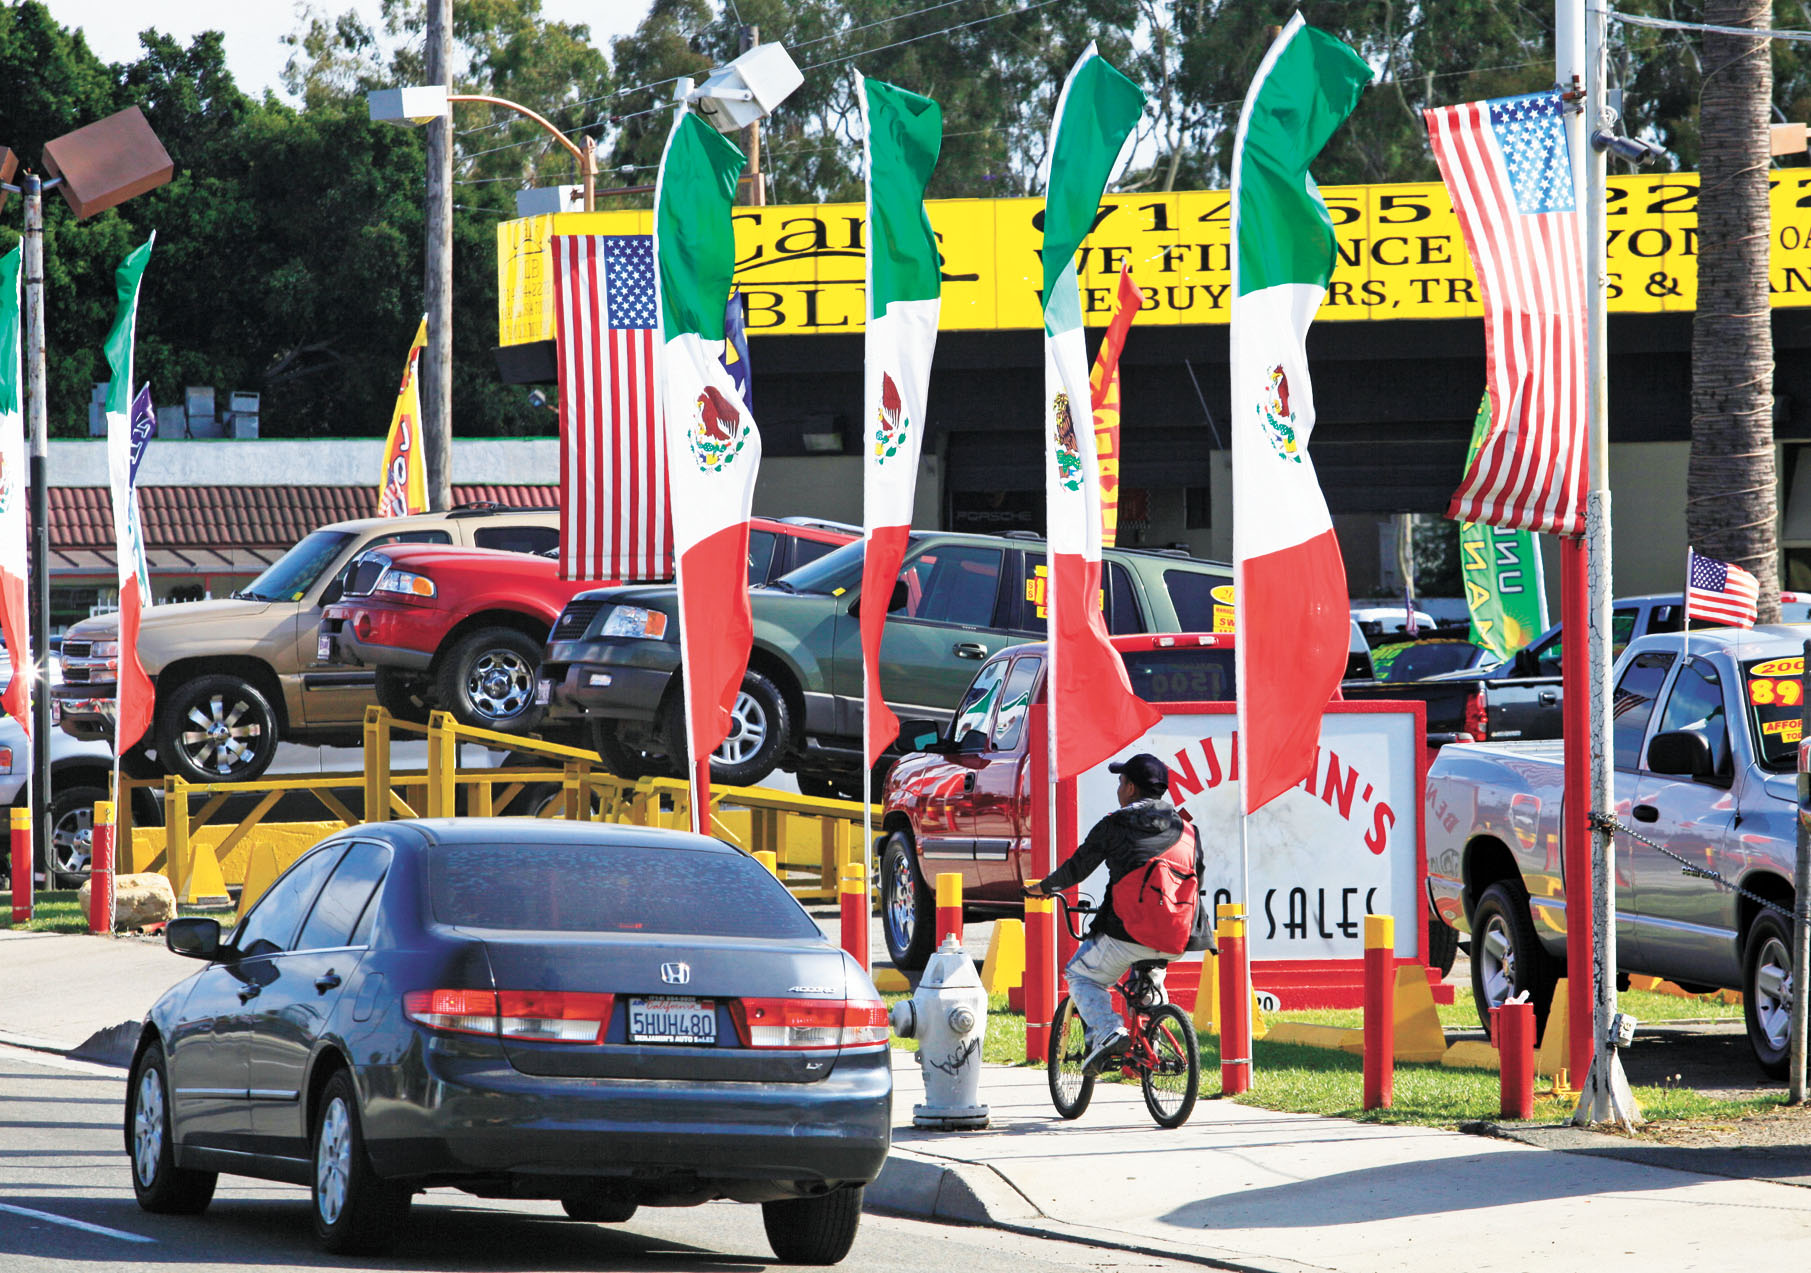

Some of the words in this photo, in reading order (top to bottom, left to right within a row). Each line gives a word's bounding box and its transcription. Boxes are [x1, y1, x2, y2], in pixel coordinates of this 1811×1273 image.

[1645, 271, 1684, 298] &
[1761, 661, 1804, 674] 200
[646, 1000, 700, 1012] California
[633, 1012, 713, 1037] 5HUH480
